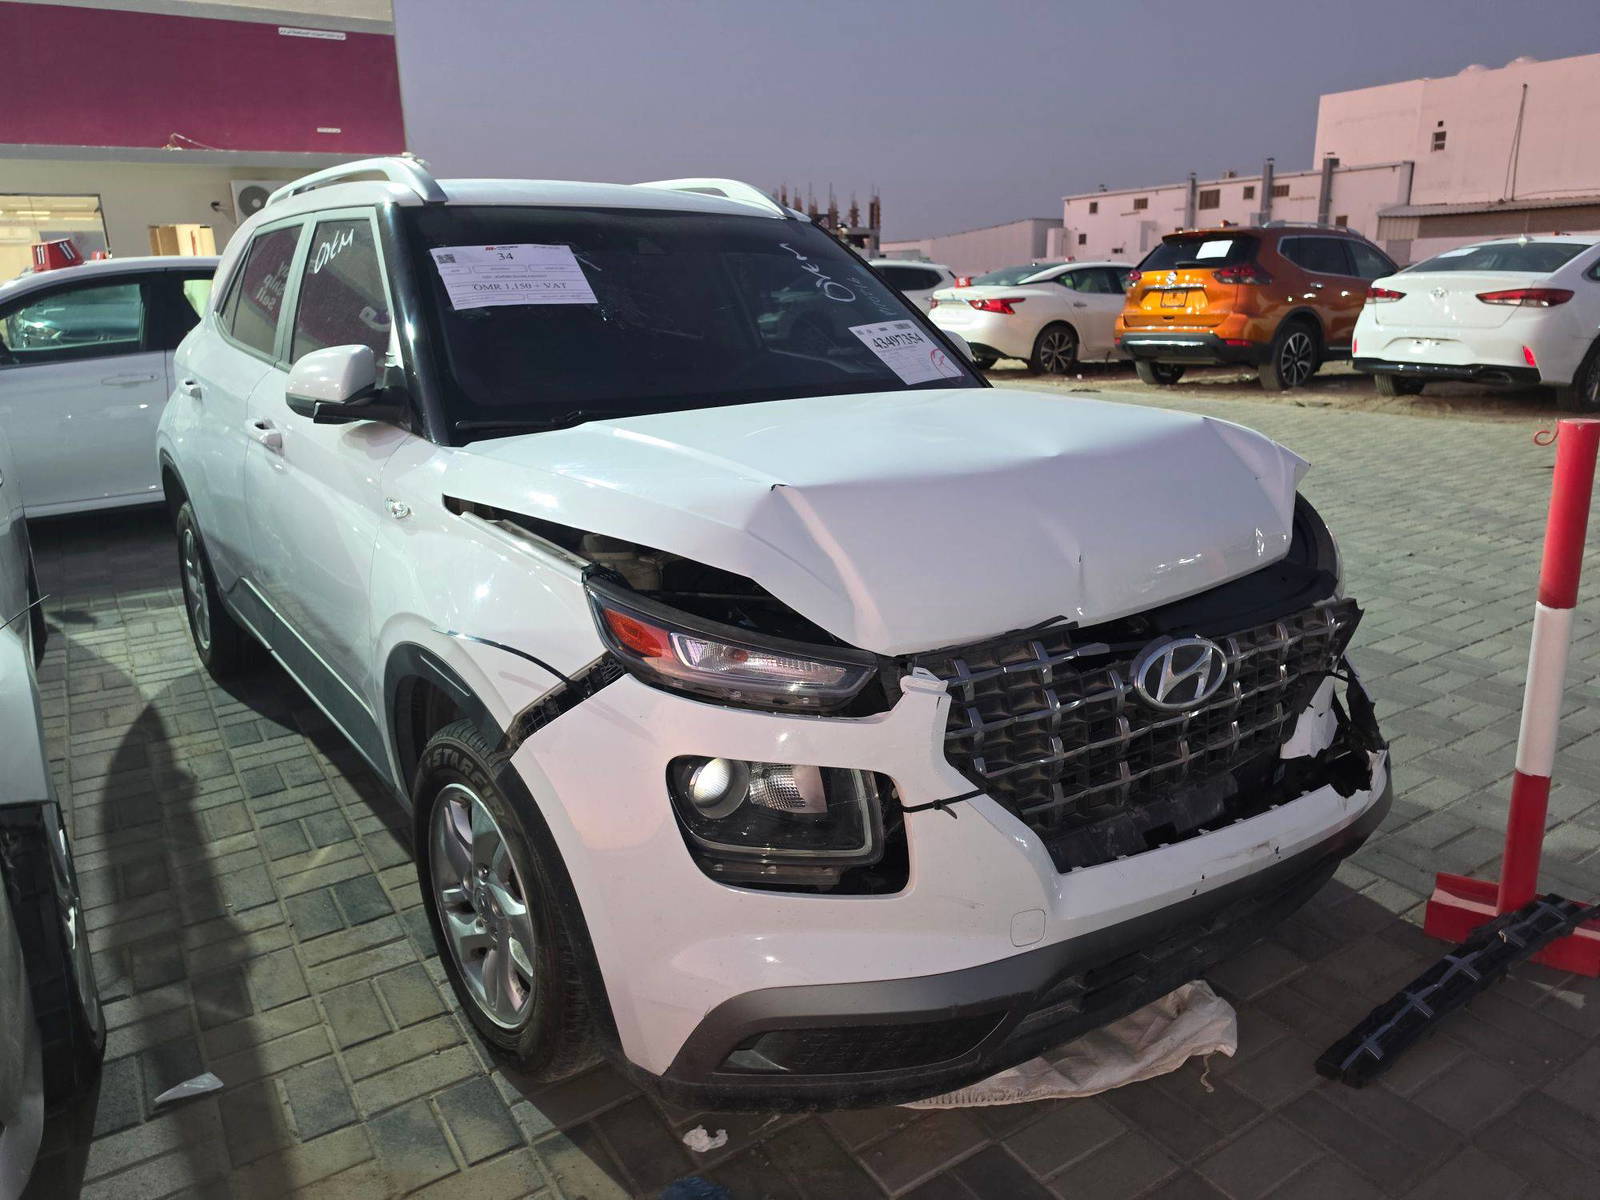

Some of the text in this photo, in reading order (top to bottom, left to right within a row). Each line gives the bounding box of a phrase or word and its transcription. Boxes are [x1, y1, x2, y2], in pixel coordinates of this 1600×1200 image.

[36, 245, 46, 265] 11
[59, 241, 75, 260] 11
[498, 252, 514, 261] 34
[473, 283, 502, 291] OMR
[543, 281, 567, 289] VAT
[872, 332, 926, 350] 43497354
